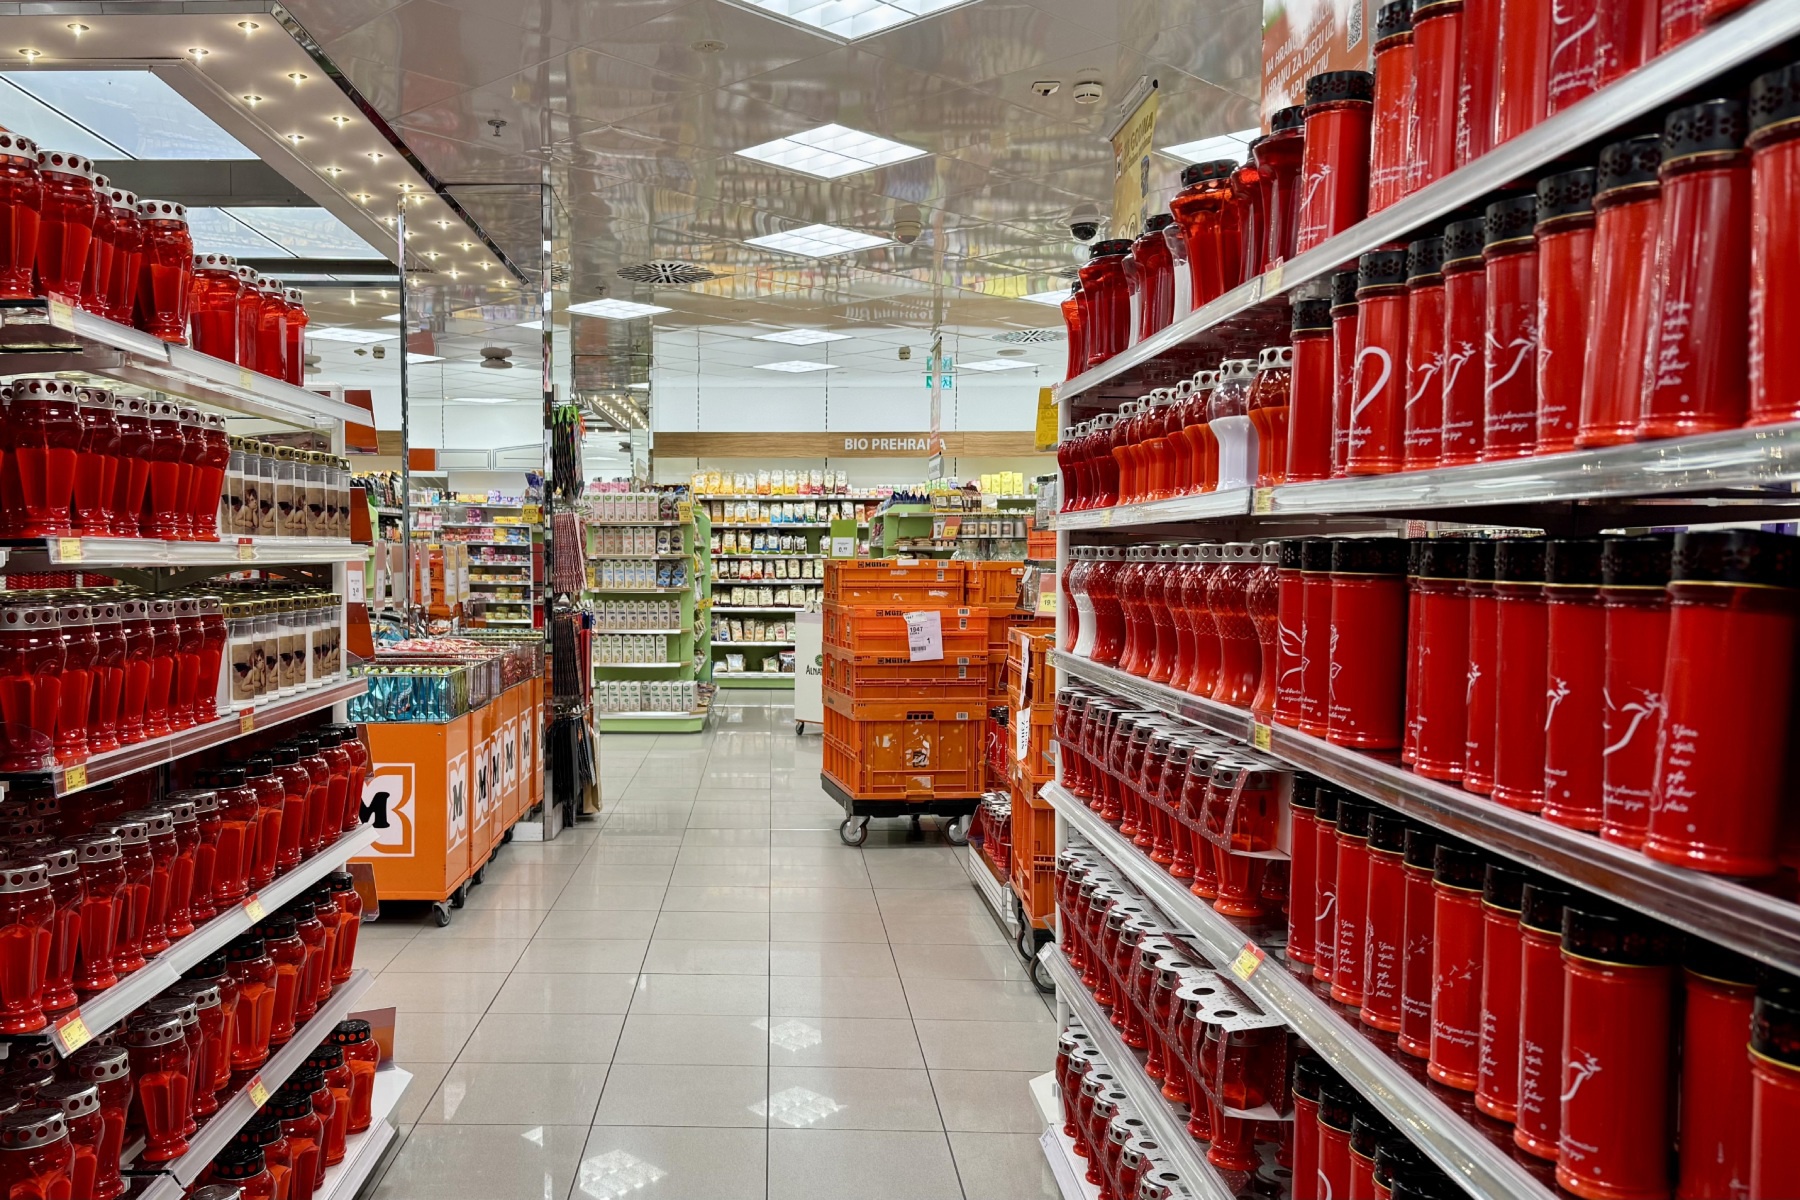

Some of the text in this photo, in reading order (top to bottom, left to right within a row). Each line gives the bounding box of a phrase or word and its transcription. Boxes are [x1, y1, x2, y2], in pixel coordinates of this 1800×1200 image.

[1292, 52, 1302, 75] ZA
[1303, 28, 1324, 65] DJECU
[1325, 18, 1335, 42] UZ
[844, 438, 869, 451] BIO
[805, 664, 823, 676] ALNA
